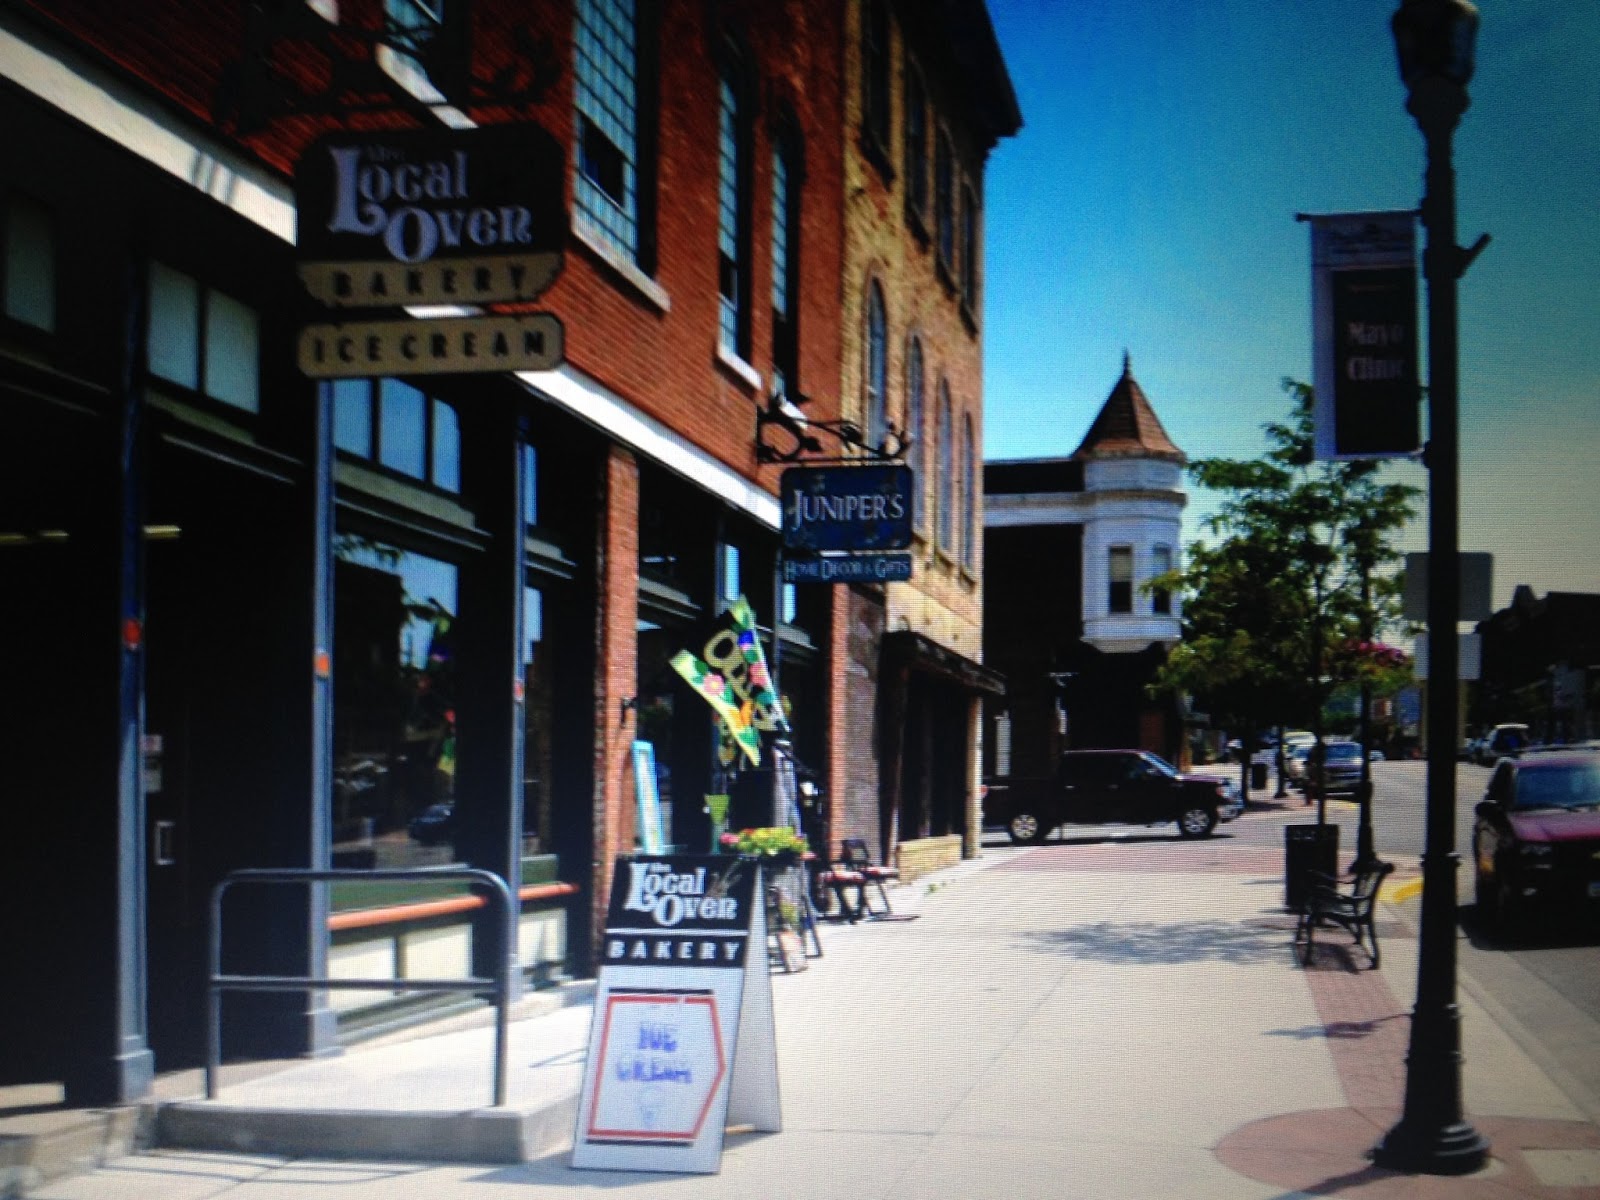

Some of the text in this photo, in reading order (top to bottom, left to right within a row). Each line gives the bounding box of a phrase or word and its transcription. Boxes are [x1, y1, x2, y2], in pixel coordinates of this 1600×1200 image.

[327, 145, 470, 236] Local
[331, 262, 526, 297] BAKERY
[312, 330, 546, 364] ICE CREAM
[786, 488, 905, 531] JUNIPER'S
[623, 861, 707, 912] Local
[607, 940, 740, 960] BAKERY
